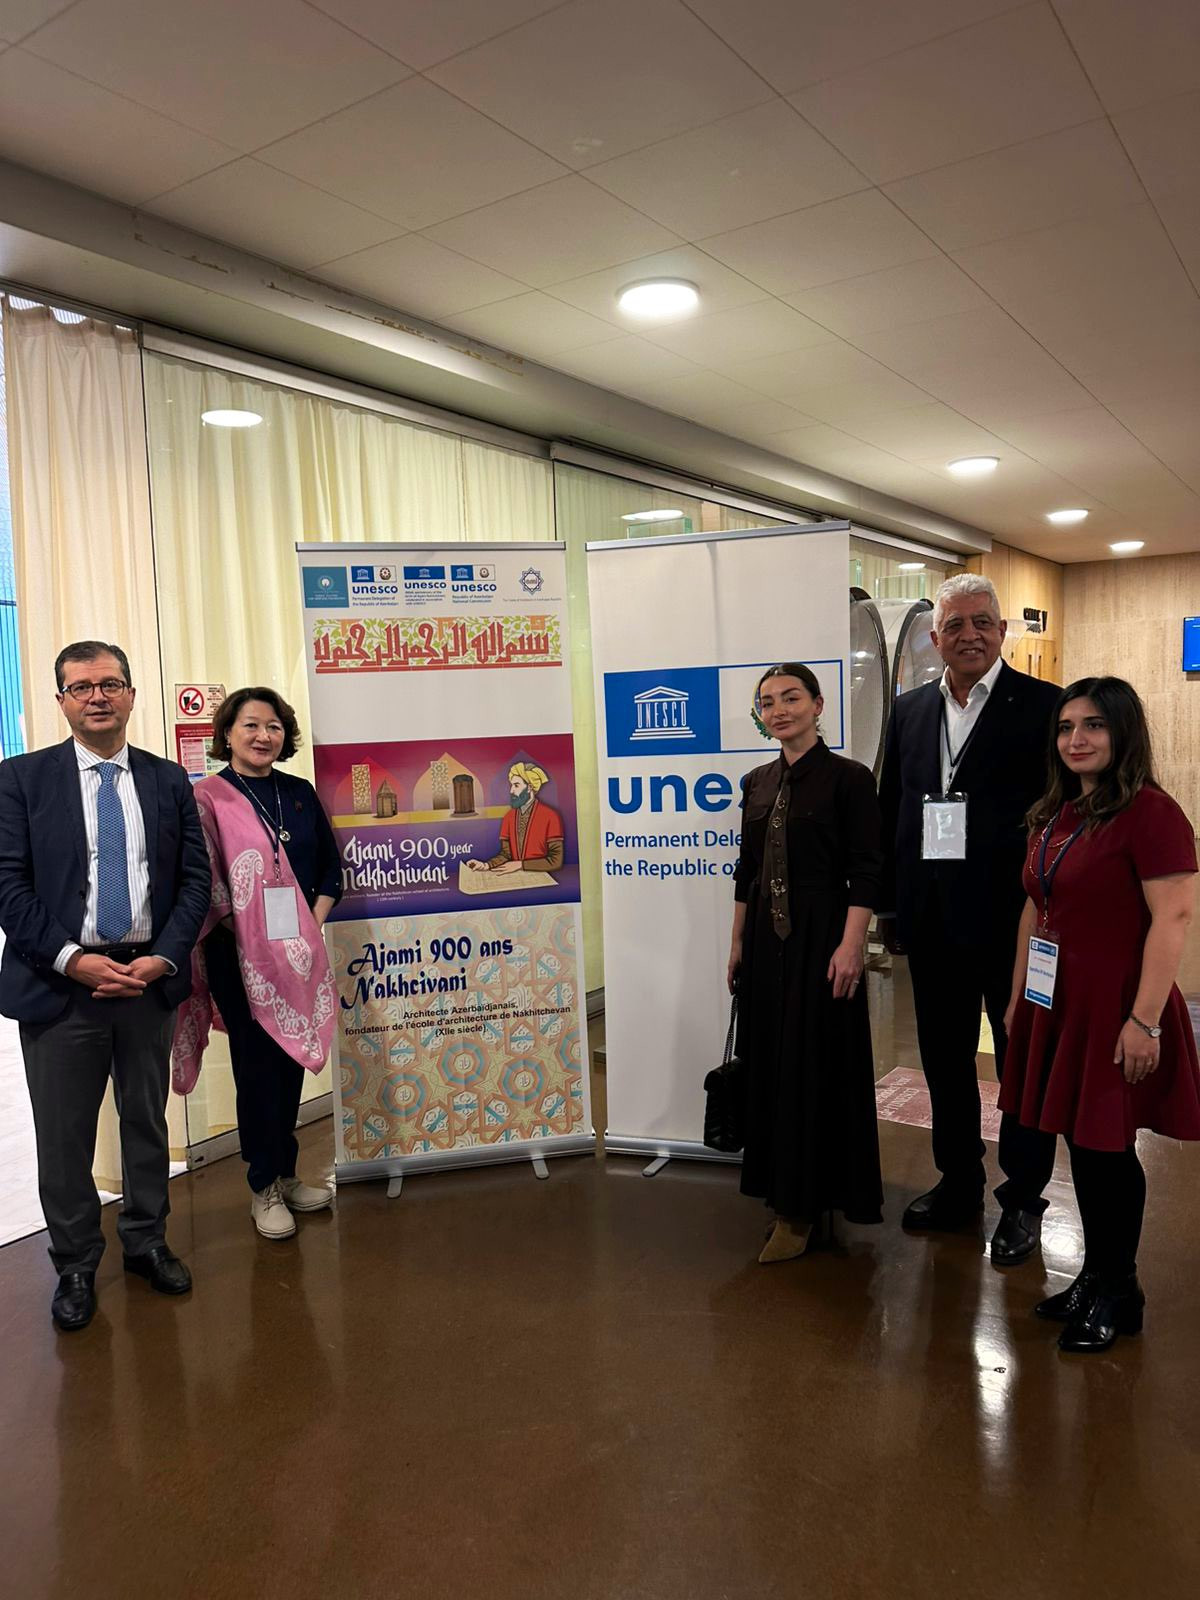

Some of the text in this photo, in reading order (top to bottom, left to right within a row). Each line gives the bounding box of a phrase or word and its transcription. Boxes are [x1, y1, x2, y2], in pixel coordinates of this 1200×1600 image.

[351, 585, 399, 594] unesco
[404, 581, 447, 589] unesco
[451, 584, 497, 592] unesco
[636, 700, 688, 729] UNESCO
[607, 772, 745, 814] une
[343, 834, 474, 869] Ajami 900 year
[605, 831, 699, 848] Permanent
[341, 857, 450, 892] Nakhchivani
[605, 860, 633, 876] the
[637, 858, 717, 880] Republic
[347, 936, 514, 976] Ajami 900 ans
[340, 967, 468, 1010] Nakhcivani
[345, 1006, 571, 1036] fondateur de l'école d'architecture de Nakhitchevan
[403, 1007, 449, 1020] Architecte
